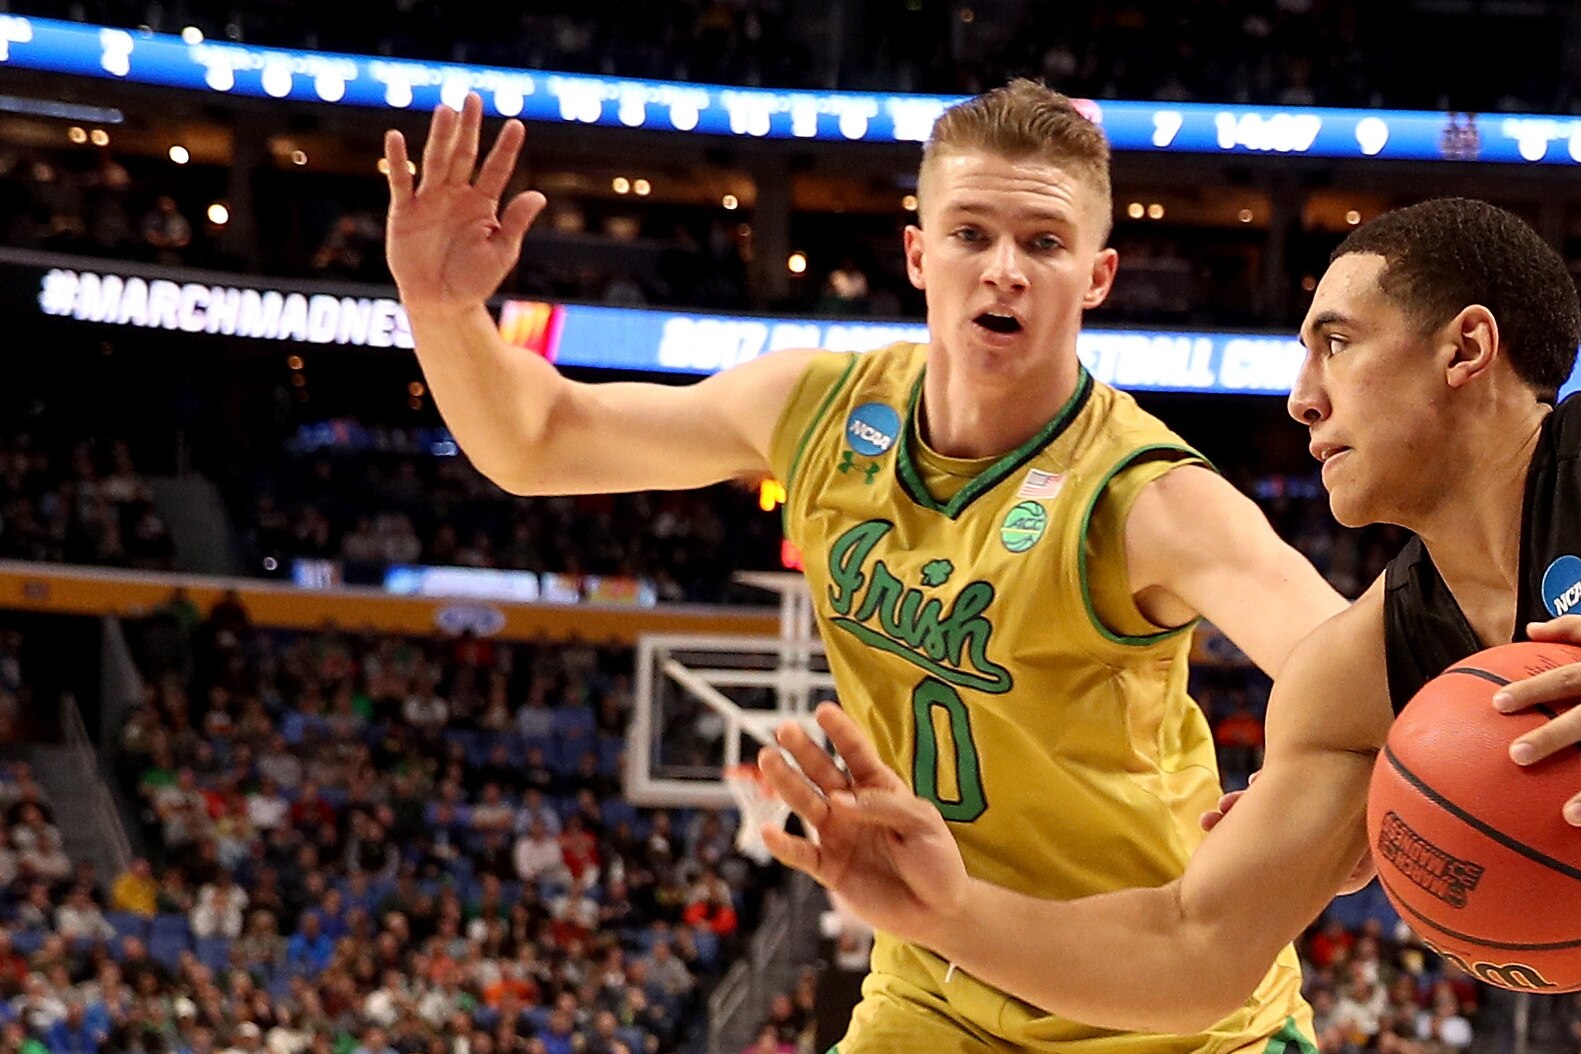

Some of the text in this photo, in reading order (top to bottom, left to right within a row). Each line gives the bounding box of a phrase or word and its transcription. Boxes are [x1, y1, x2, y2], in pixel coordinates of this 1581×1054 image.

[39, 268, 415, 349] #MARCHMADNES
[849, 420, 894, 450] NCAA
[829, 518, 1013, 694] Irish
[912, 677, 988, 823] 0
